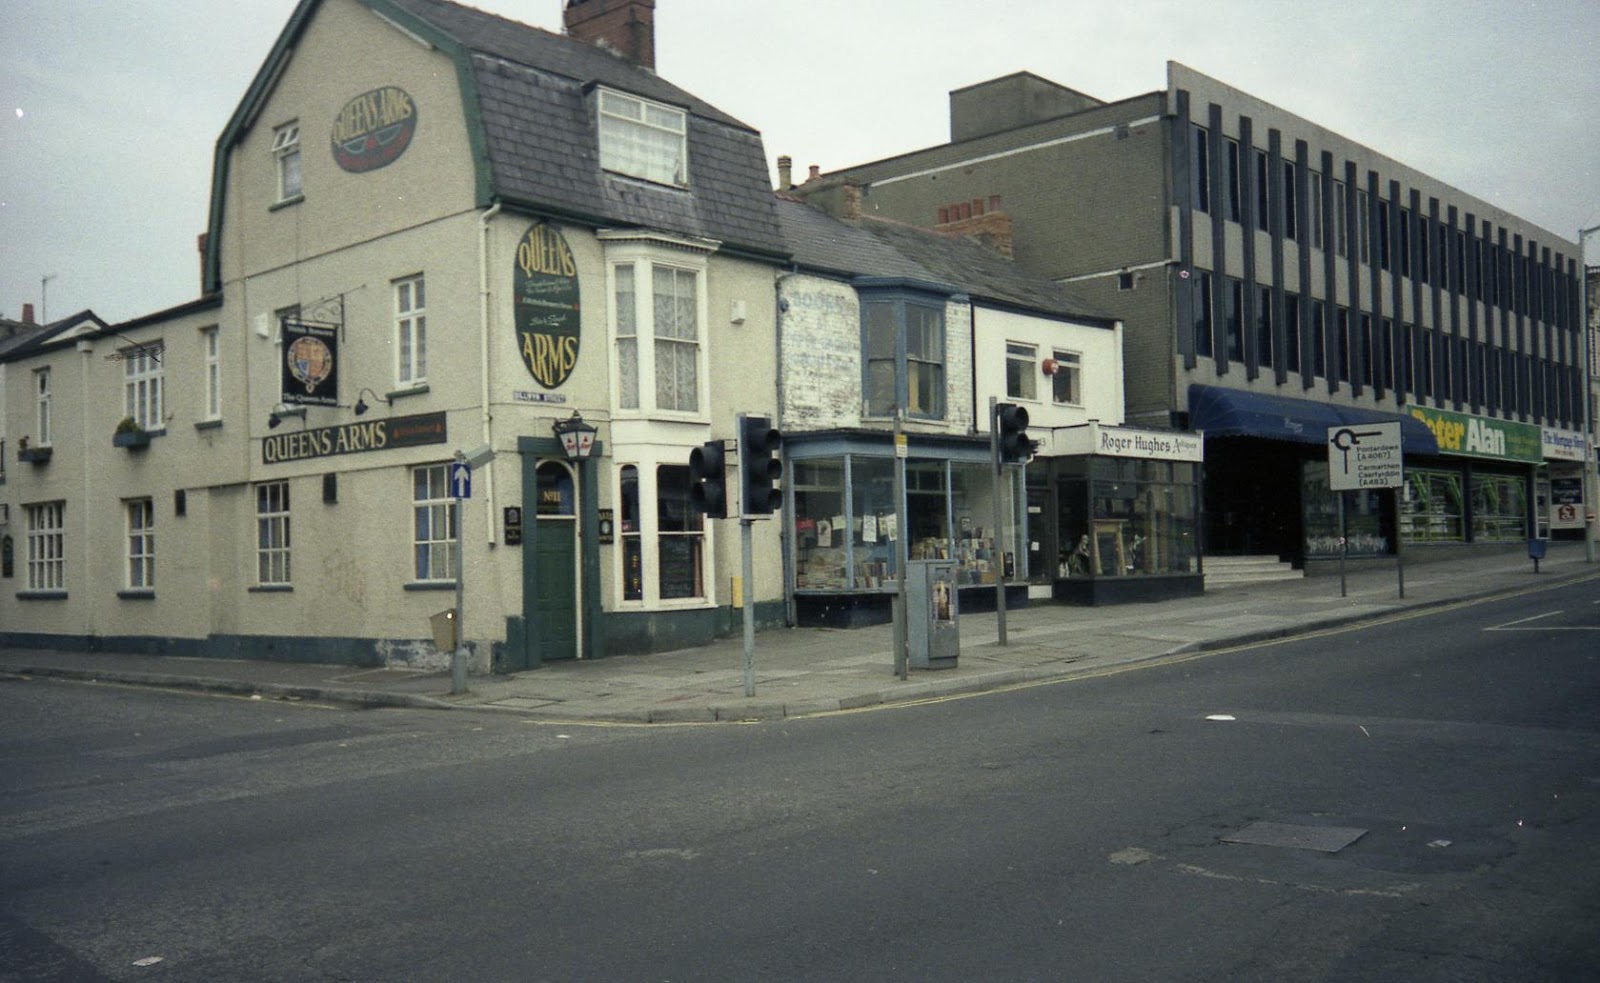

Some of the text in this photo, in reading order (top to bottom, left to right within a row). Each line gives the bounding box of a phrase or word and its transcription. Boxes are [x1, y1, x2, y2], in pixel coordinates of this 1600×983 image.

[519, 225, 576, 279] QUEENS
[521, 332, 578, 386] ARMS
[265, 421, 386, 463] QUEENS ARMS
[1102, 432, 1132, 453] Roger
[1135, 435, 1171, 455] Hughes
[1466, 418, 1505, 455] Alan
